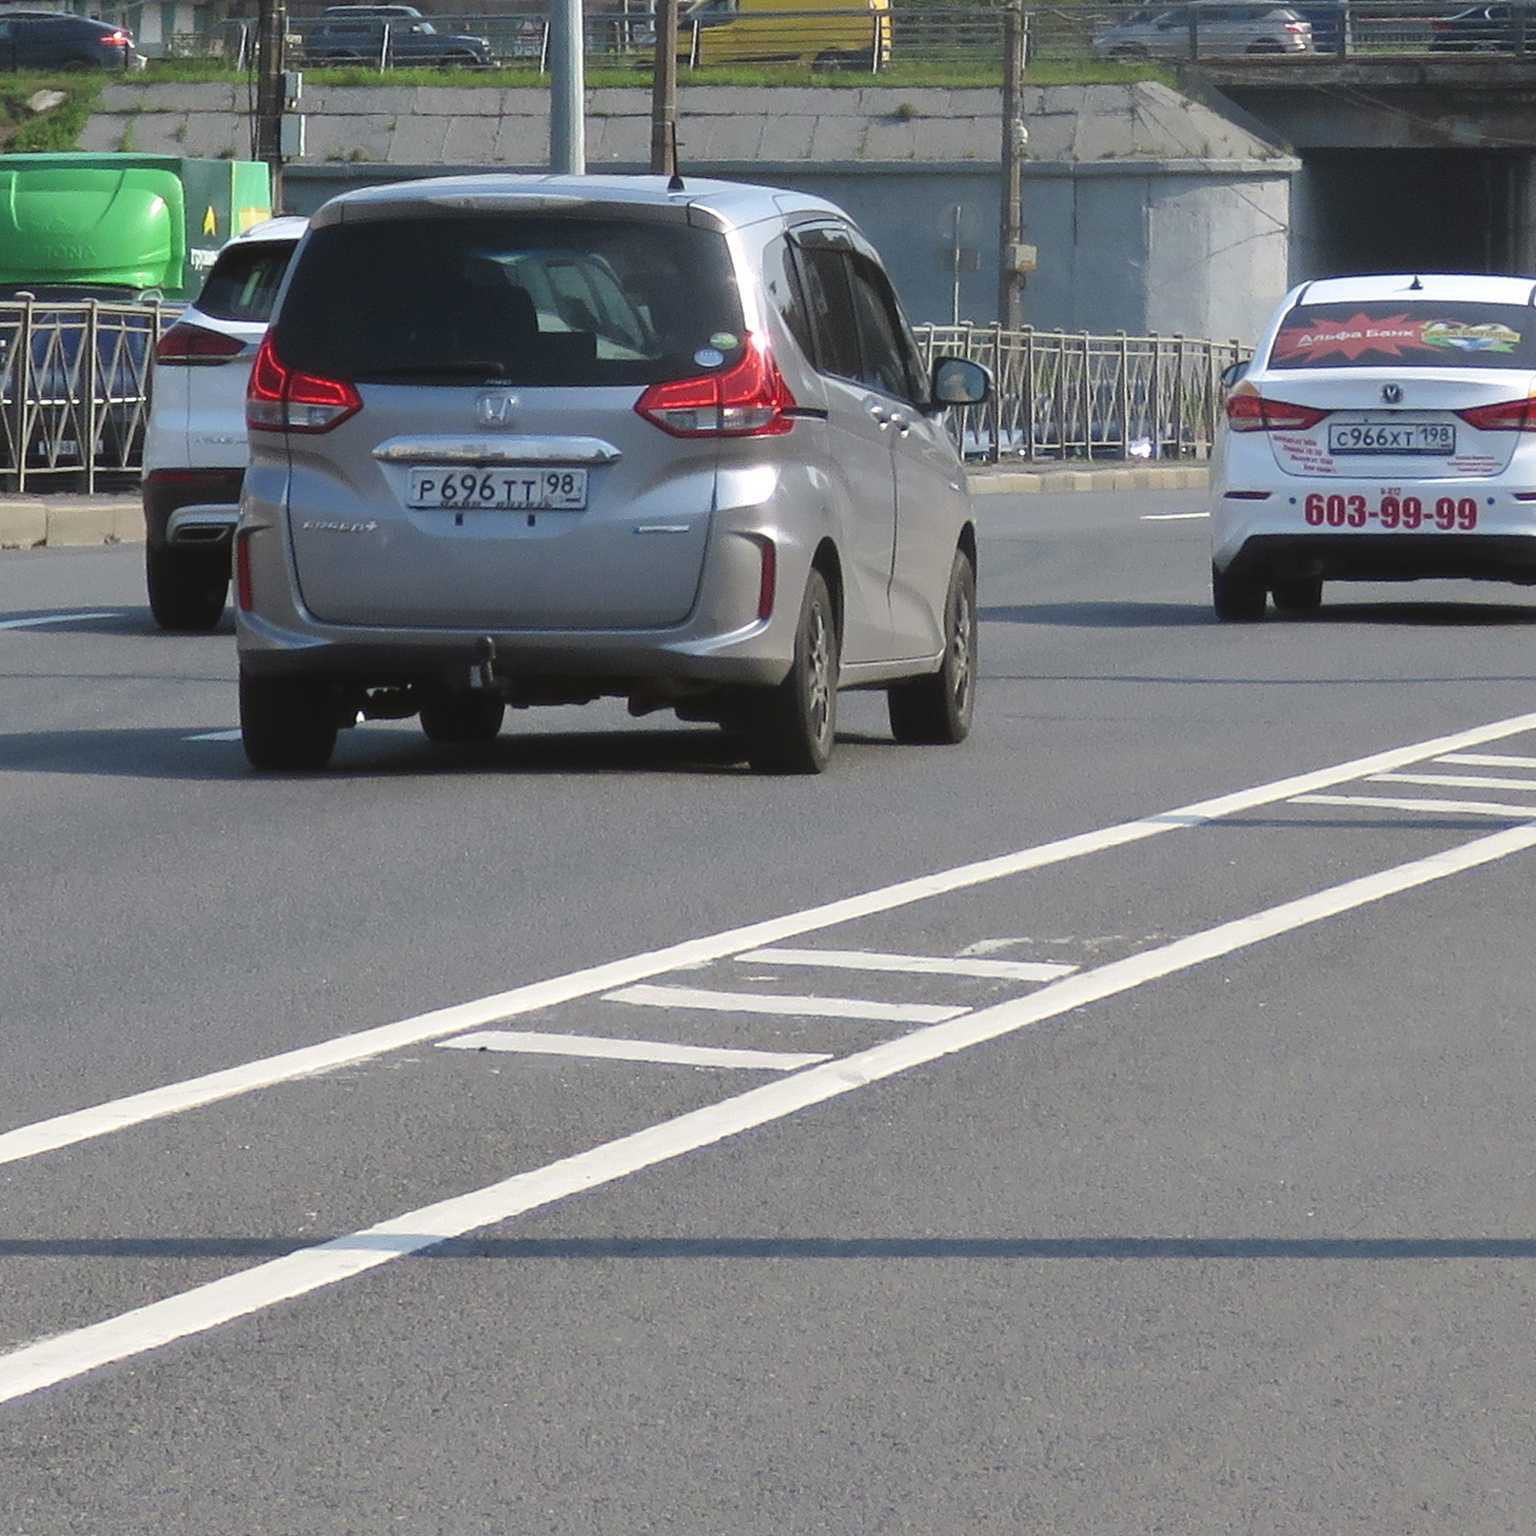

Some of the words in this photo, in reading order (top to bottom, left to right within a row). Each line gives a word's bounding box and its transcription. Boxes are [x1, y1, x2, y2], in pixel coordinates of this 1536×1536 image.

[1297, 331, 1362, 348] Альфа
[1365, 328, 1415, 339] Банк
[1421, 427, 1449, 442] 198
[547, 474, 573, 494] 98
[1304, 494, 1478, 531] 603-99-99
